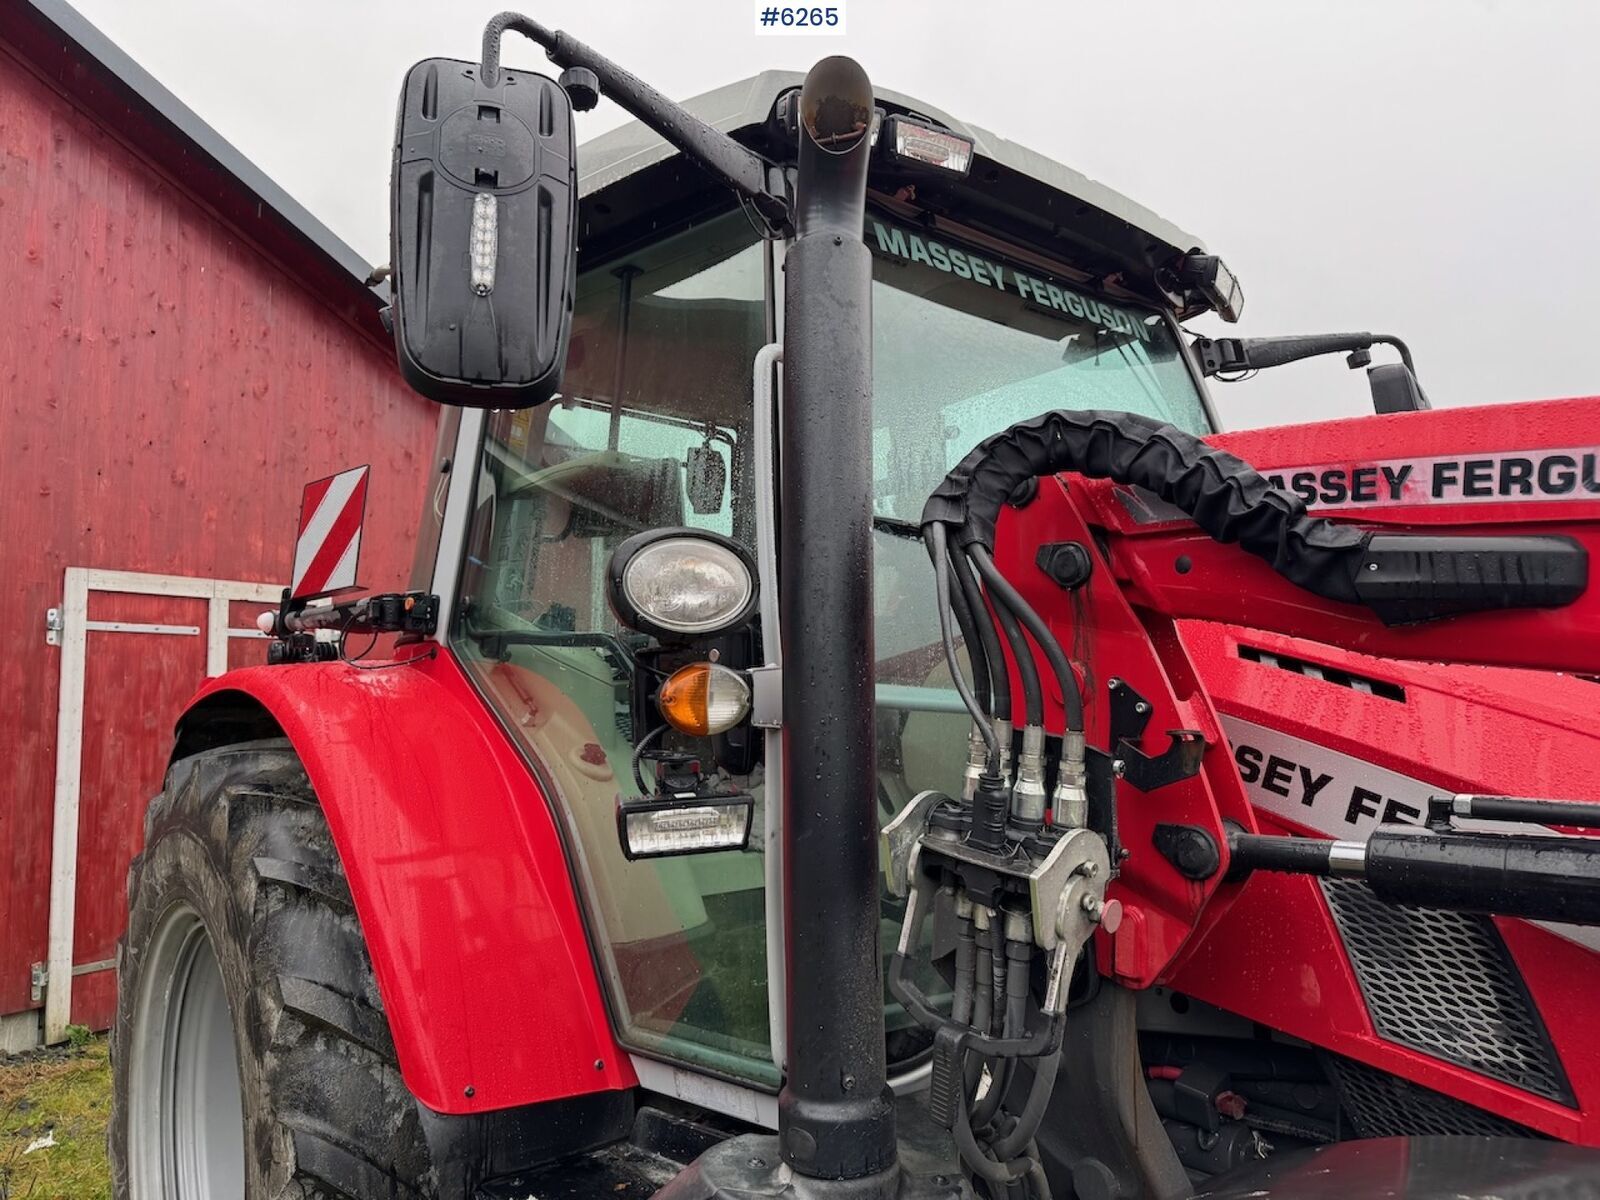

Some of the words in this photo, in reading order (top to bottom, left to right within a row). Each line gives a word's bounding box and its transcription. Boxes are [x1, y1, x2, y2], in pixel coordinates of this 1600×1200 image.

[873, 222, 1005, 291] MASSEY
[1013, 271, 1151, 342] FERGUSON
[1228, 740, 1334, 807] SEY
